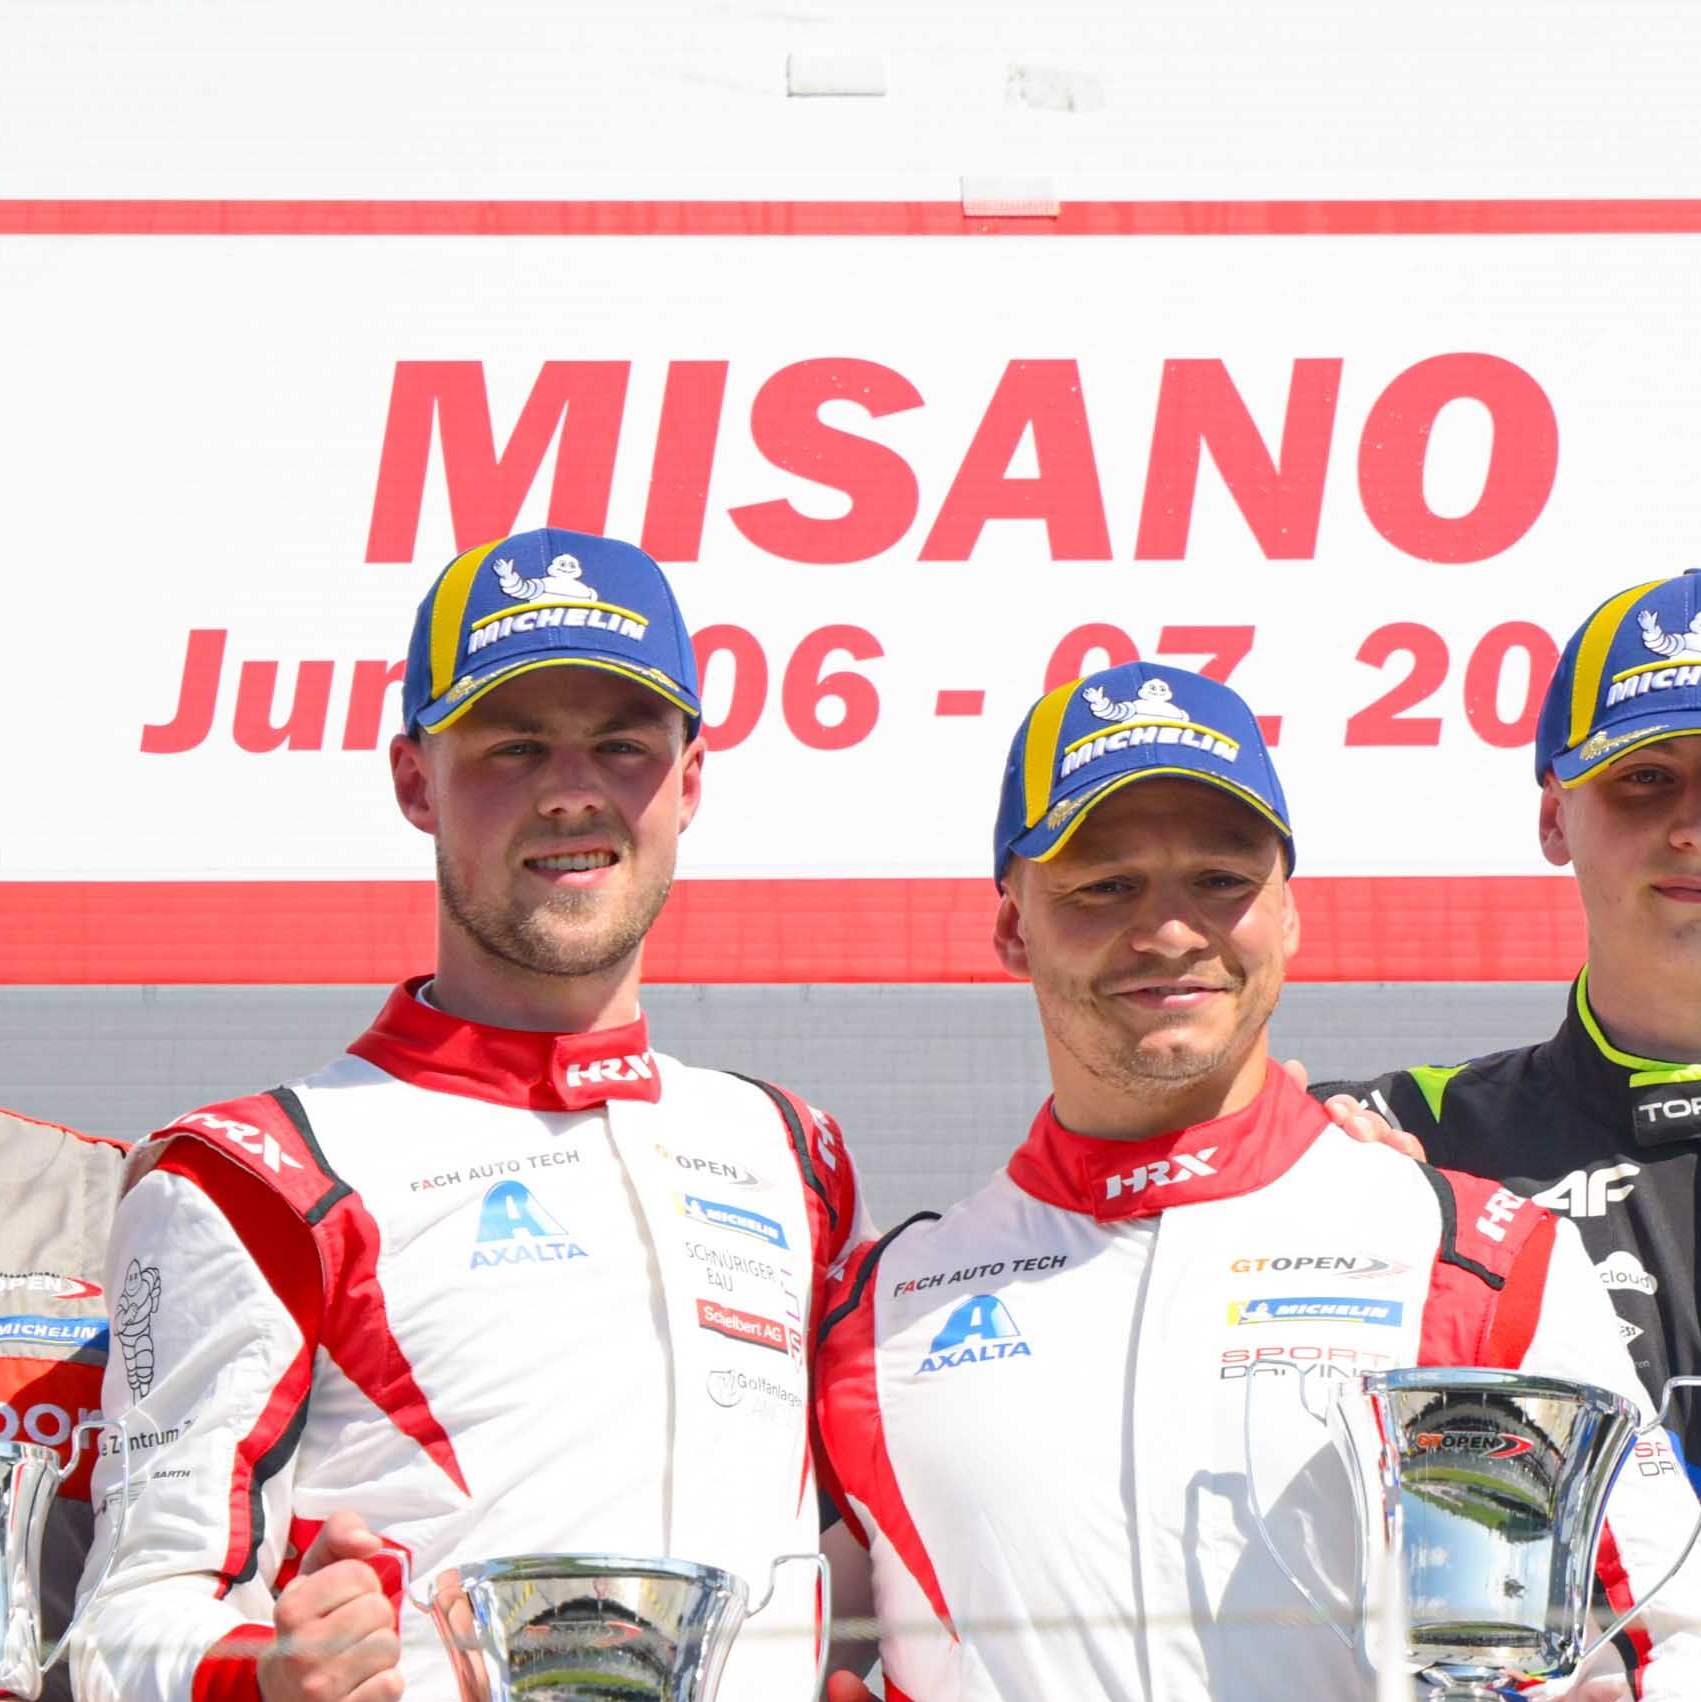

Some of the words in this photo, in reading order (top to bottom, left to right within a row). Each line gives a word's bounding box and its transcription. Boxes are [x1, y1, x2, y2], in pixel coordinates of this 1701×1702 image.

[365, 352, 1560, 566] MISANO
[466, 602, 647, 652] MICHELIN
[140, 628, 405, 754] Jun
[699, 623, 885, 752] 06
[1344, 620, 1559, 749] 20
[1060, 716, 1239, 778] MICHELIN
[410, 1172, 462, 1192] FACH
[469, 1159, 521, 1181] AUTO
[526, 1150, 581, 1169] TECH
[1105, 1147, 1219, 1200] HRX
[470, 1242, 589, 1270] AXALTA
[893, 1273, 945, 1298] FACH
[946, 1261, 1005, 1285] AUTO
[1011, 1254, 1068, 1276] TECH
[1275, 1303, 1390, 1318] MICHELIN
[914, 1341, 1032, 1376] AXALTA
